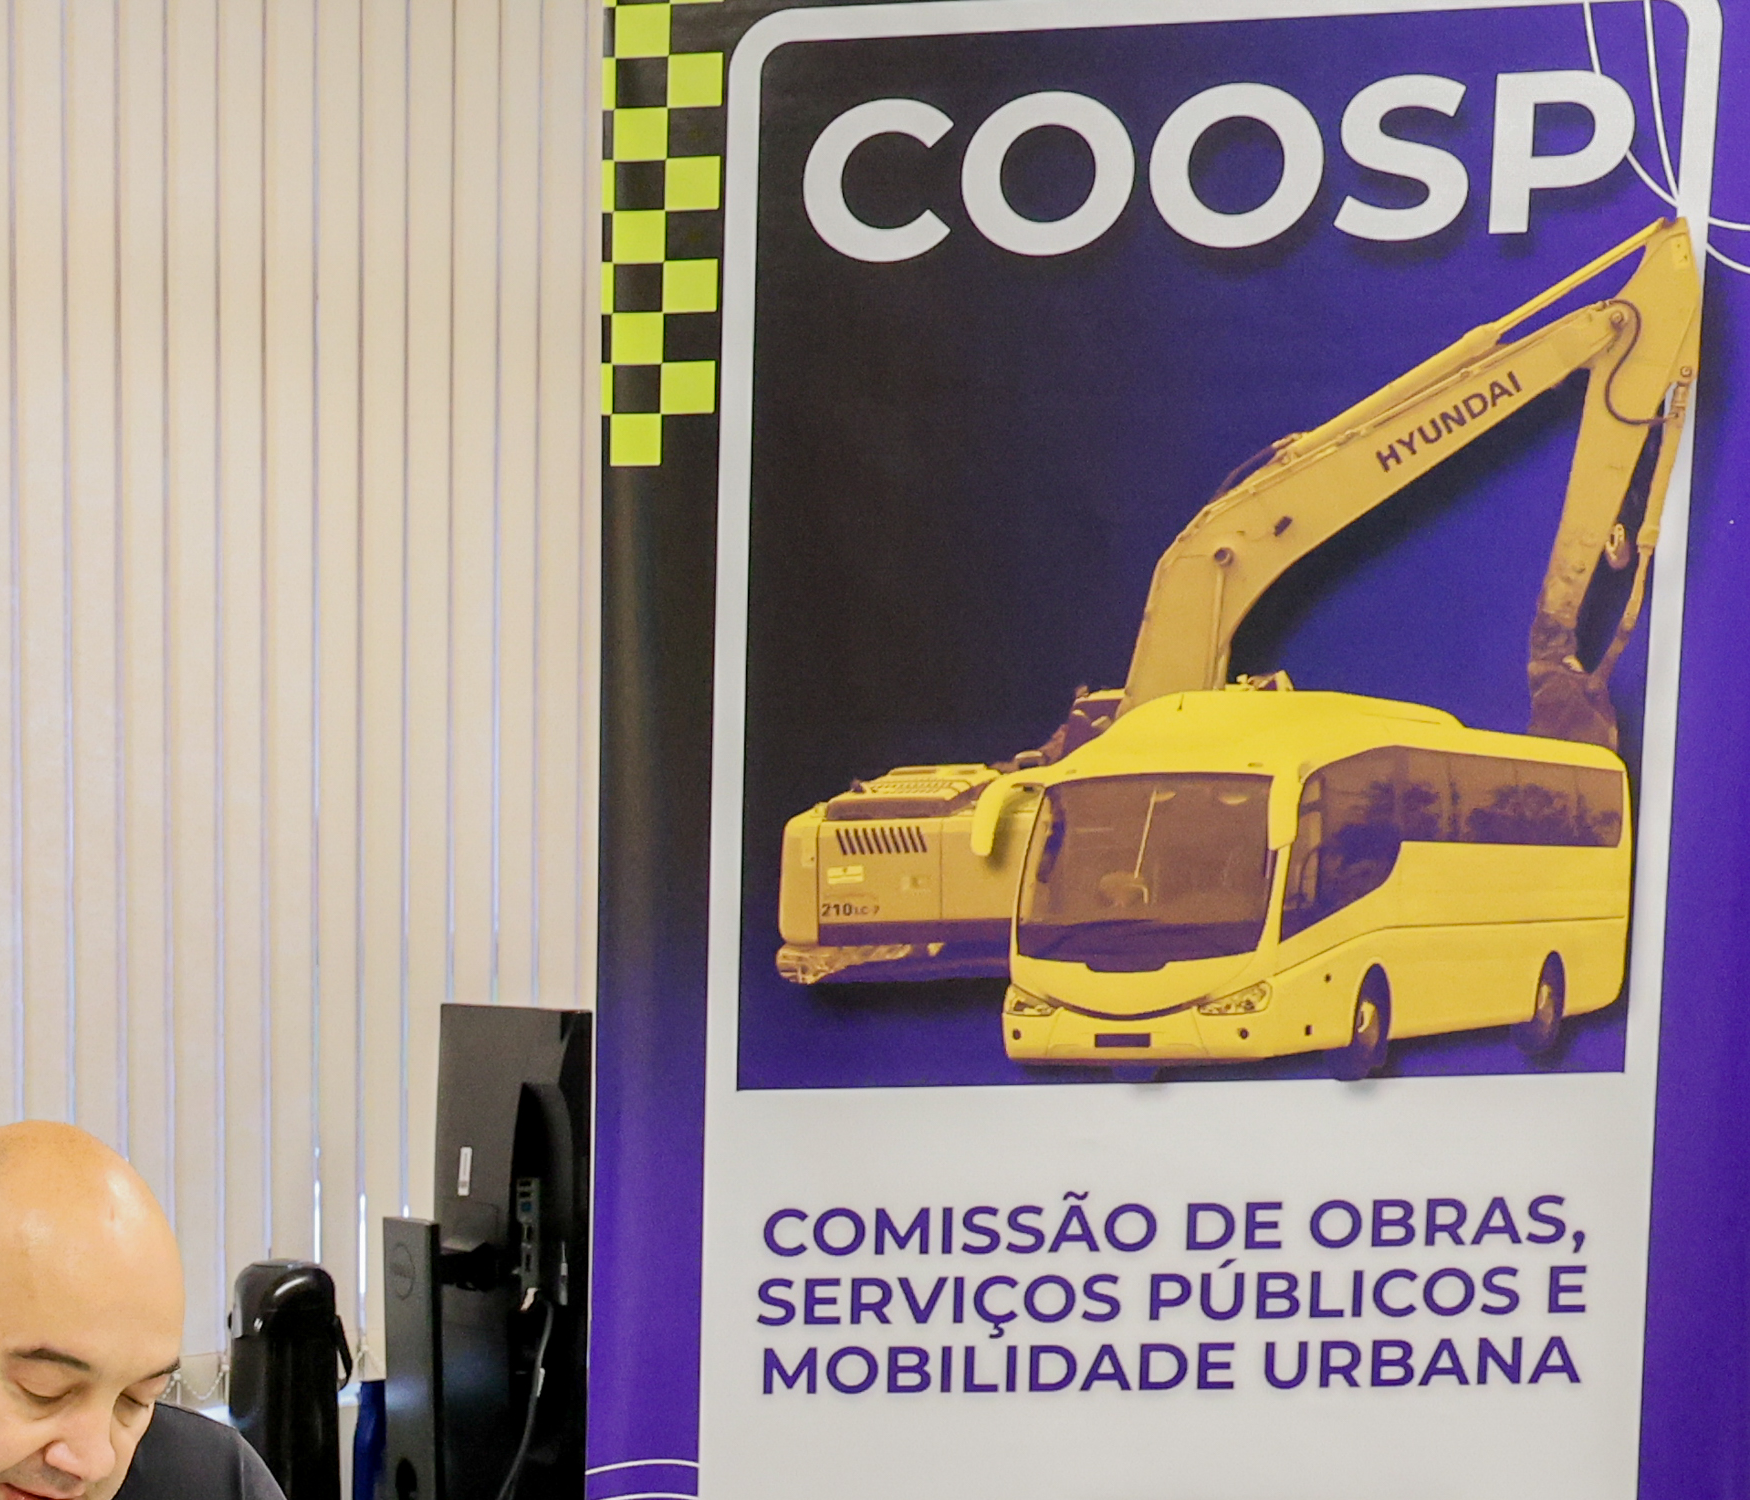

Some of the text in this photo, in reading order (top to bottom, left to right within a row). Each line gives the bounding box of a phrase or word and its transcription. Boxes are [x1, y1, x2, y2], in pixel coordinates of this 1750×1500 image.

[803, 70, 1636, 263] COOSP
[1375, 370, 1522, 473] HYUNDAI
[763, 1190, 1586, 1257] COMISSÃO DE OBRAS,
[756, 1258, 1587, 1338] SERVIÇOS PÚBLICOS E
[762, 1335, 1581, 1395] MOBILIDADE URBANA
